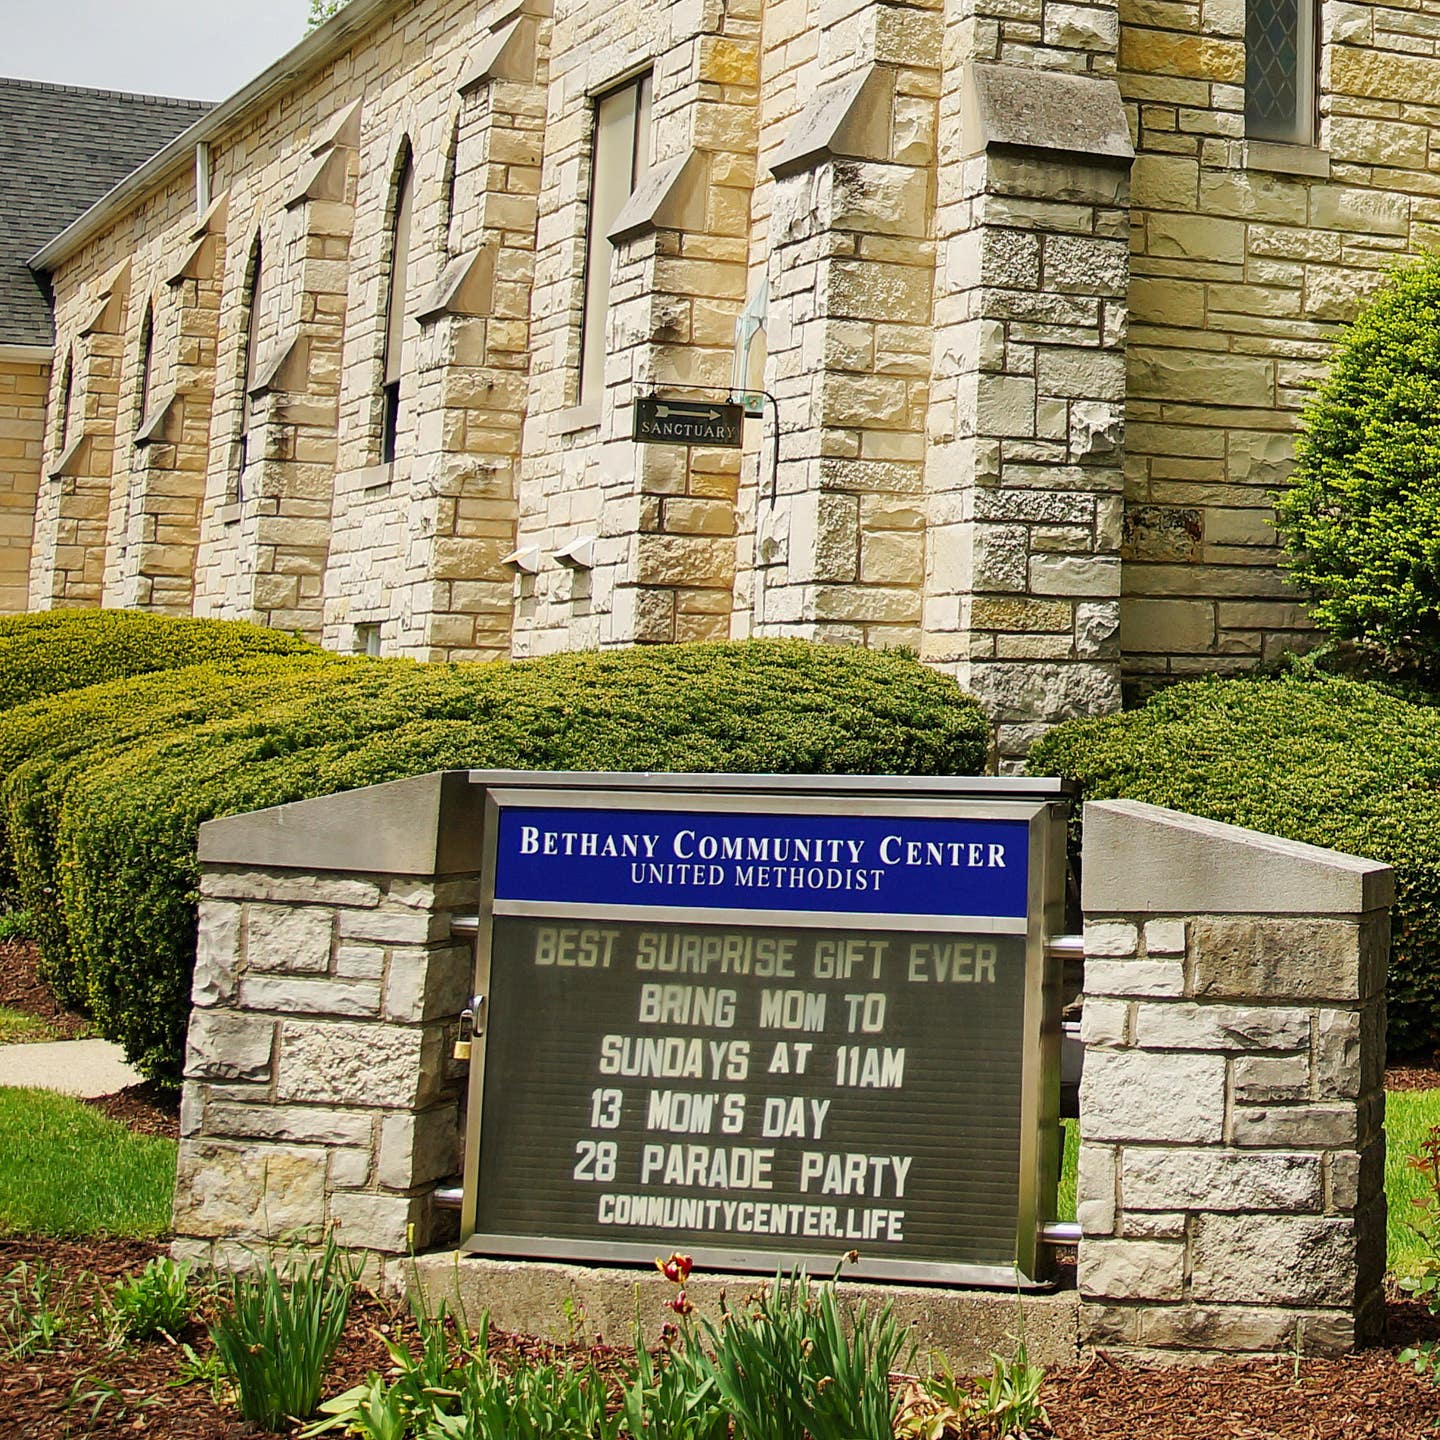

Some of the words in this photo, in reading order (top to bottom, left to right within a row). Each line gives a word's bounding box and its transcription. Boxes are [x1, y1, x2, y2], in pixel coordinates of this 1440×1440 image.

[641, 421, 736, 440] SANCTUARY
[520, 825, 661, 858] BETHANY
[673, 829, 865, 864] COMMUNITY
[879, 835, 1007, 868] CENTER
[630, 862, 725, 887] UNITED
[734, 866, 886, 891] METHODIST
[534, 929, 620, 968] BEST
[635, 933, 797, 978] SURPRISE
[813, 939, 889, 980] GIFT
[907, 943, 997, 984] EVER
[639, 984, 737, 1028] BRING
[759, 989, 827, 1033] MOM
[844, 993, 886, 1033] TO
[599, 1034, 751, 1082] SUNDAYS
[768, 1042, 812, 1075] AT
[836, 1045, 906, 1089] 11AM
[590, 1088, 623, 1130] 13
[647, 1090, 746, 1135] MOM'S
[762, 1097, 831, 1140] DAY
[573, 1141, 618, 1182] 28
[641, 1144, 775, 1190] PARADE
[800, 1151, 913, 1198] PARTY
[597, 1194, 906, 1241] COMMUNITYCENTER.LIFE
